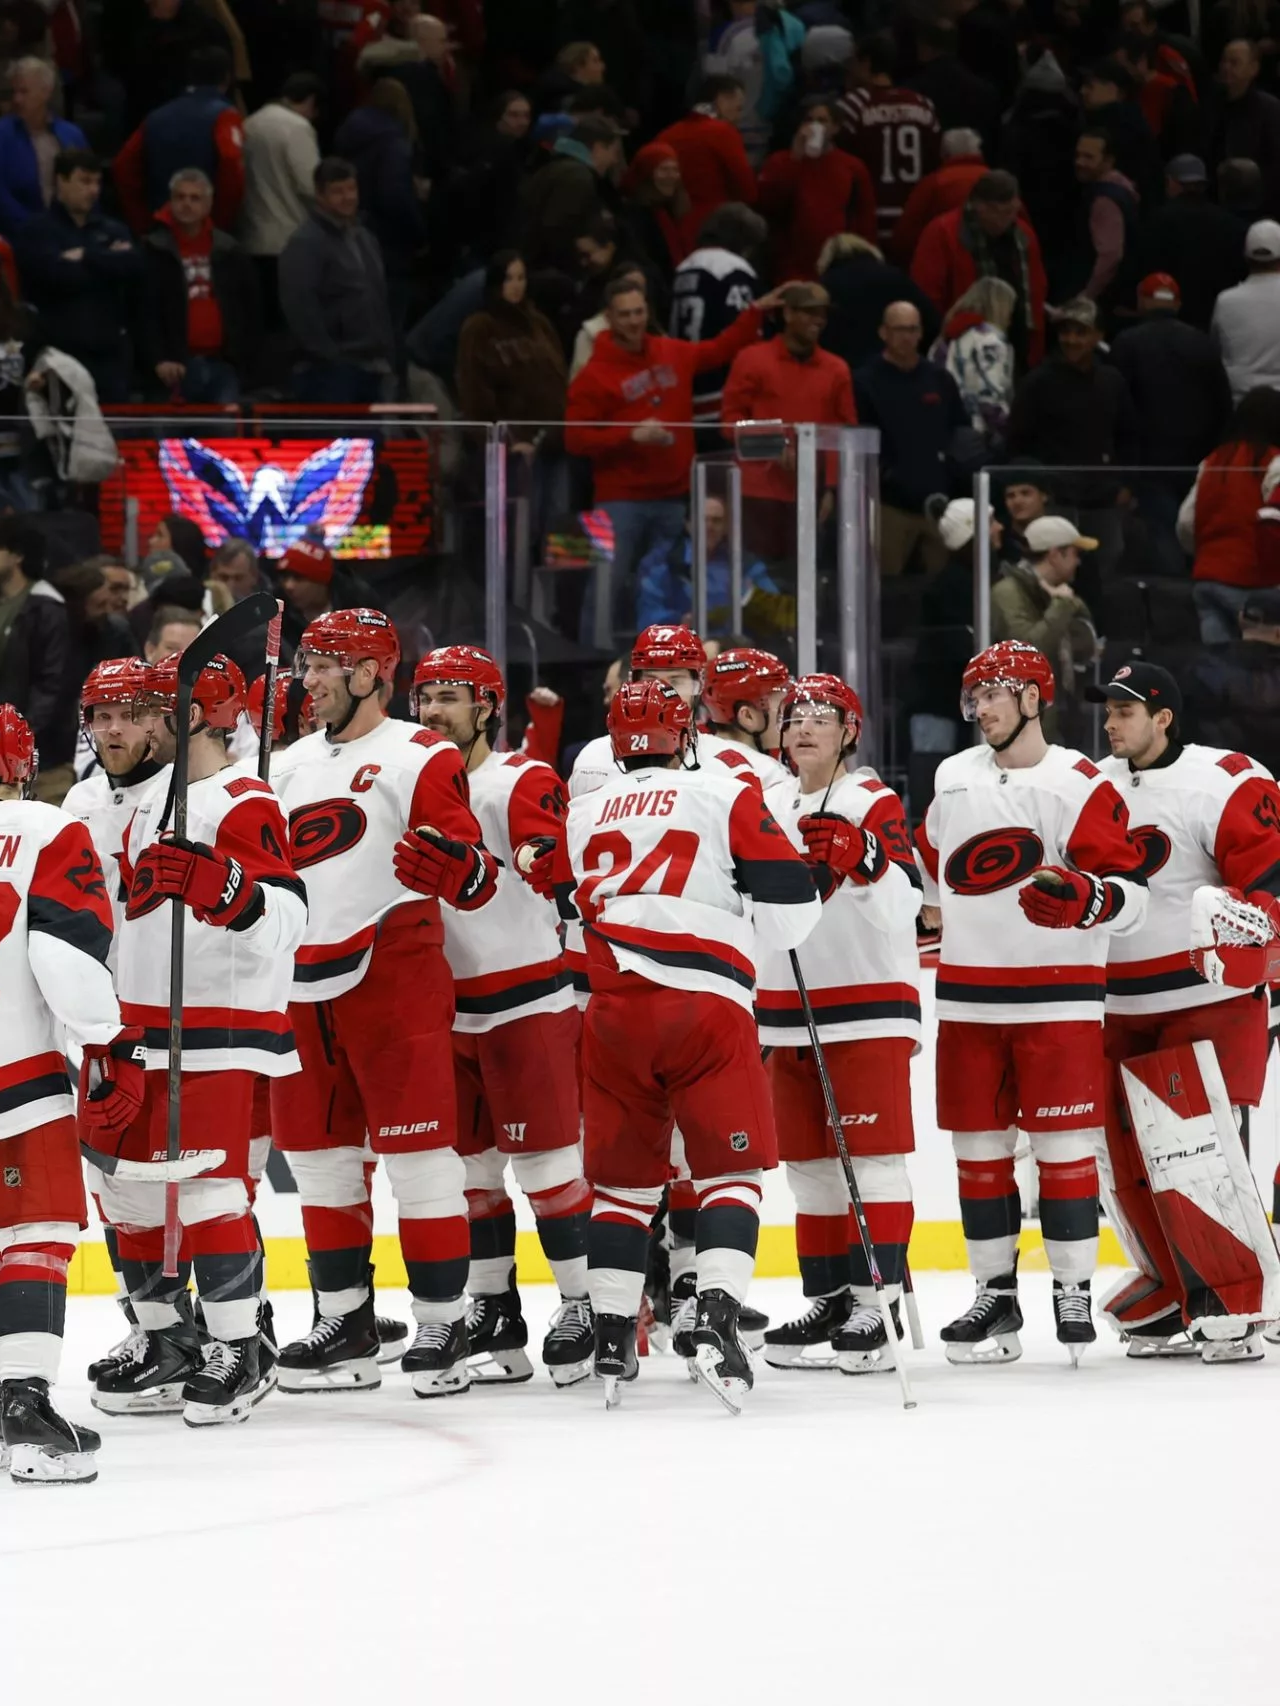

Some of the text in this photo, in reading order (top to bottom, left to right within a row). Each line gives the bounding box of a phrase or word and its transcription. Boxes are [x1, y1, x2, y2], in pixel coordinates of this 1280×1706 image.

[881, 124, 923, 184] 19
[358, 616, 387, 626] Lenovo
[716, 661, 746, 672] Lenovo
[631, 735, 649, 750] 24
[350, 764, 382, 793] C
[595, 790, 678, 826] JARVIS
[573, 829, 700, 922] 24
[1035, 1102, 1095, 1117] BAUER
[378, 1120, 439, 1137] BAUER
[1150, 1142, 1216, 1164] TRUE
[134, 1365, 159, 1384] BAUER
